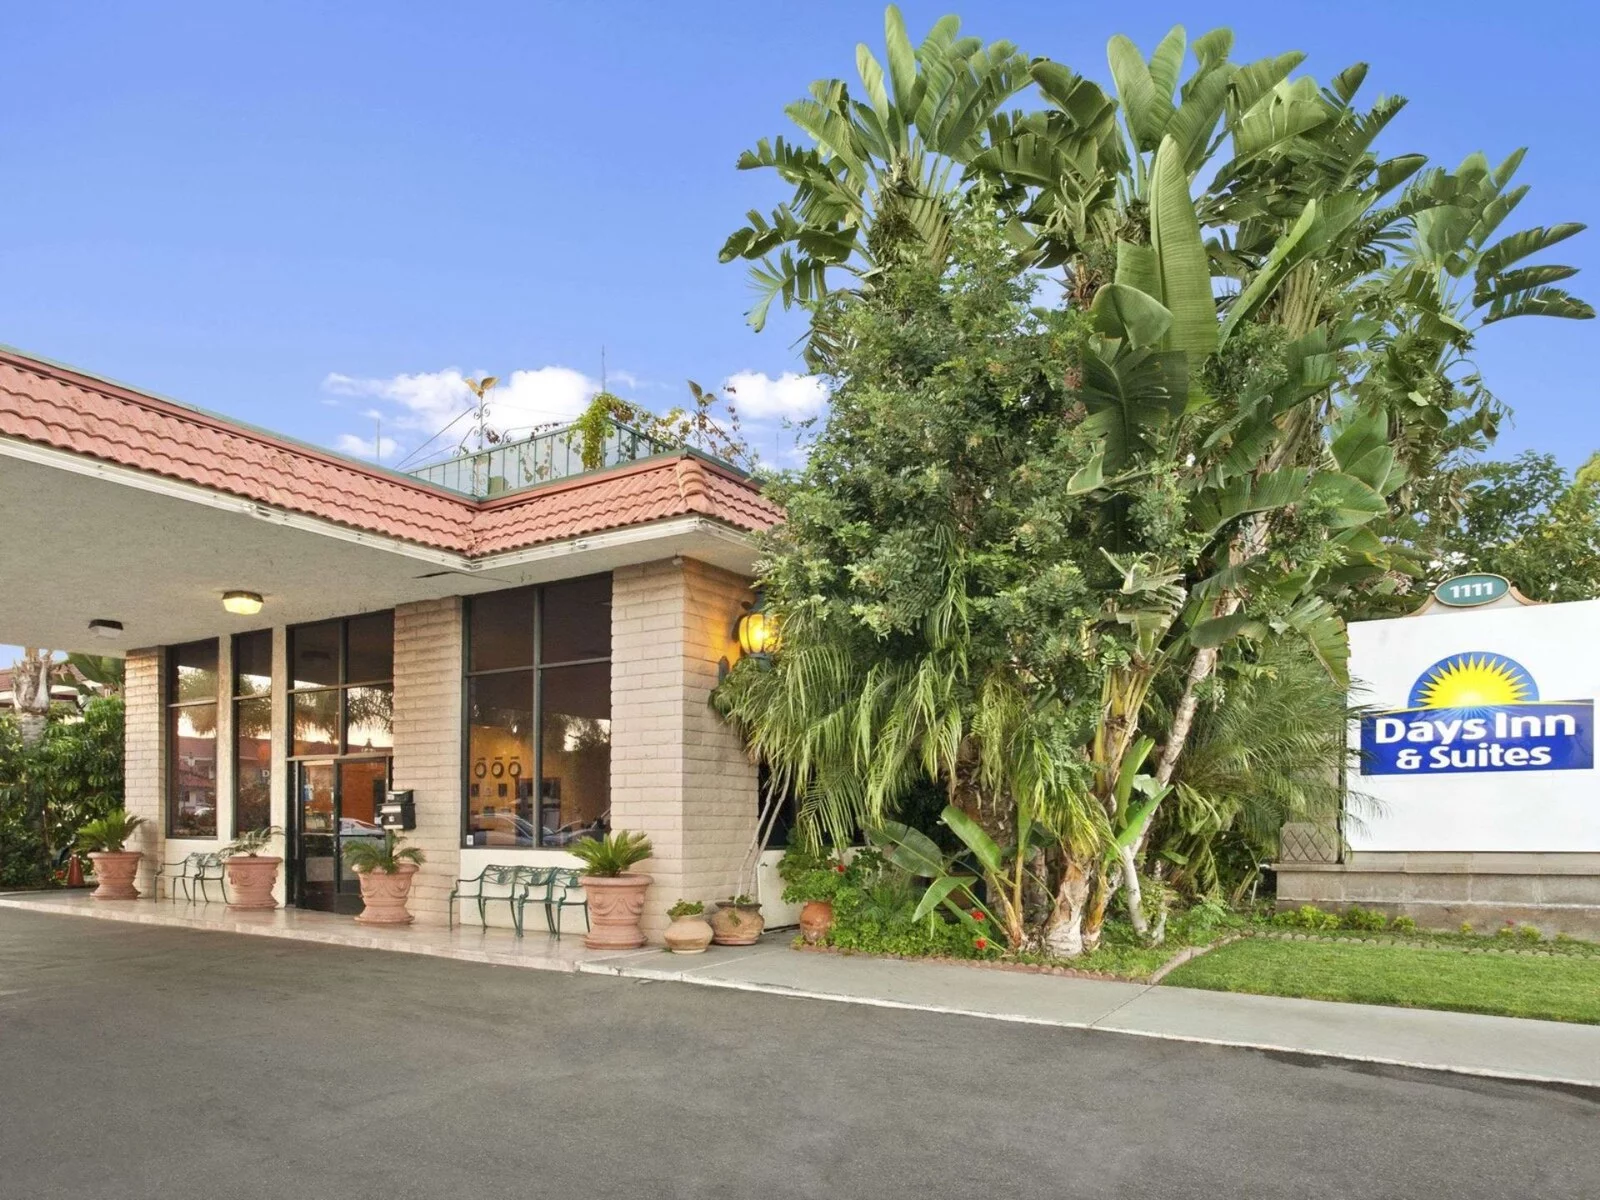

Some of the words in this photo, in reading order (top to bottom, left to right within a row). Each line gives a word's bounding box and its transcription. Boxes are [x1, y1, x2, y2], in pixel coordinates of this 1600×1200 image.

[1450, 582, 1494, 598] 1111
[1375, 717, 1487, 745] Days
[1495, 712, 1576, 738] Inn
[1396, 748, 1422, 770] &
[1429, 743, 1552, 768] Suites
